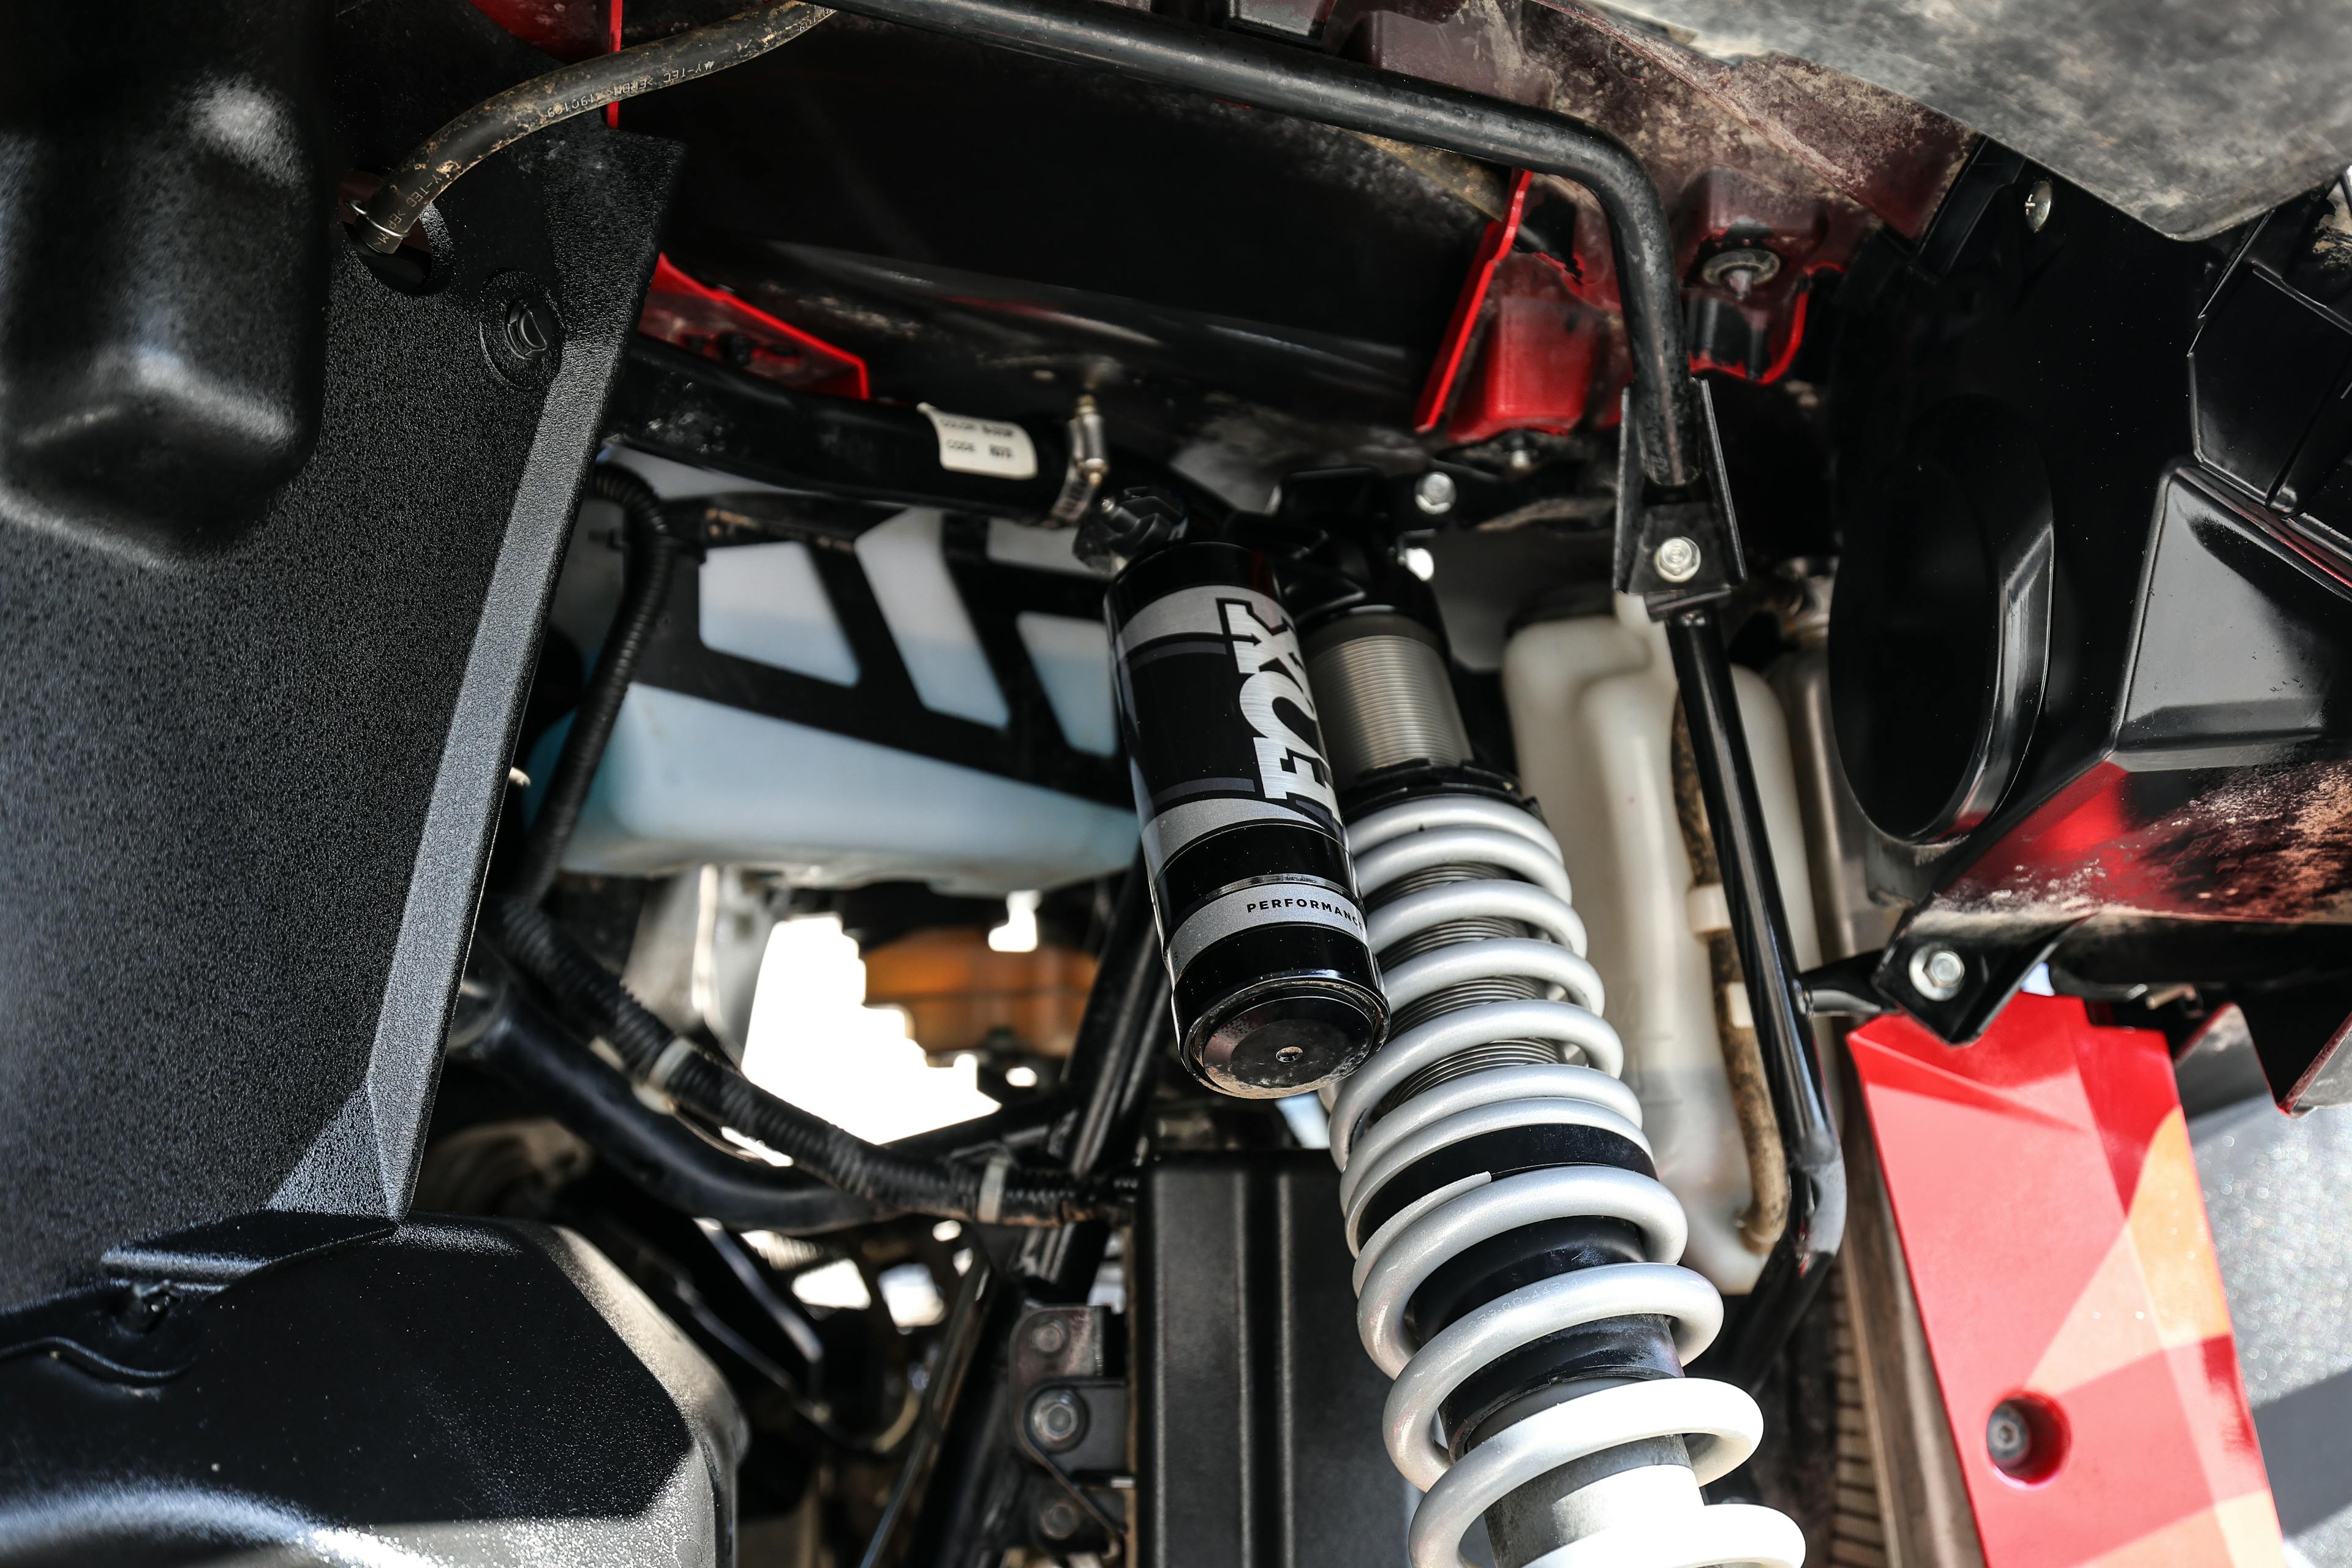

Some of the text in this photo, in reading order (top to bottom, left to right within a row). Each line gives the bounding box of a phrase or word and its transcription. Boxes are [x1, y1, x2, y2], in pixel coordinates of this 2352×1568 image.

[663, 61, 715, 83] Y-TEC
[406, 173, 443, 208] Y-TEC
[1224, 603, 1343, 827] FOX
[1246, 899, 1363, 932] PERFORMANCE
